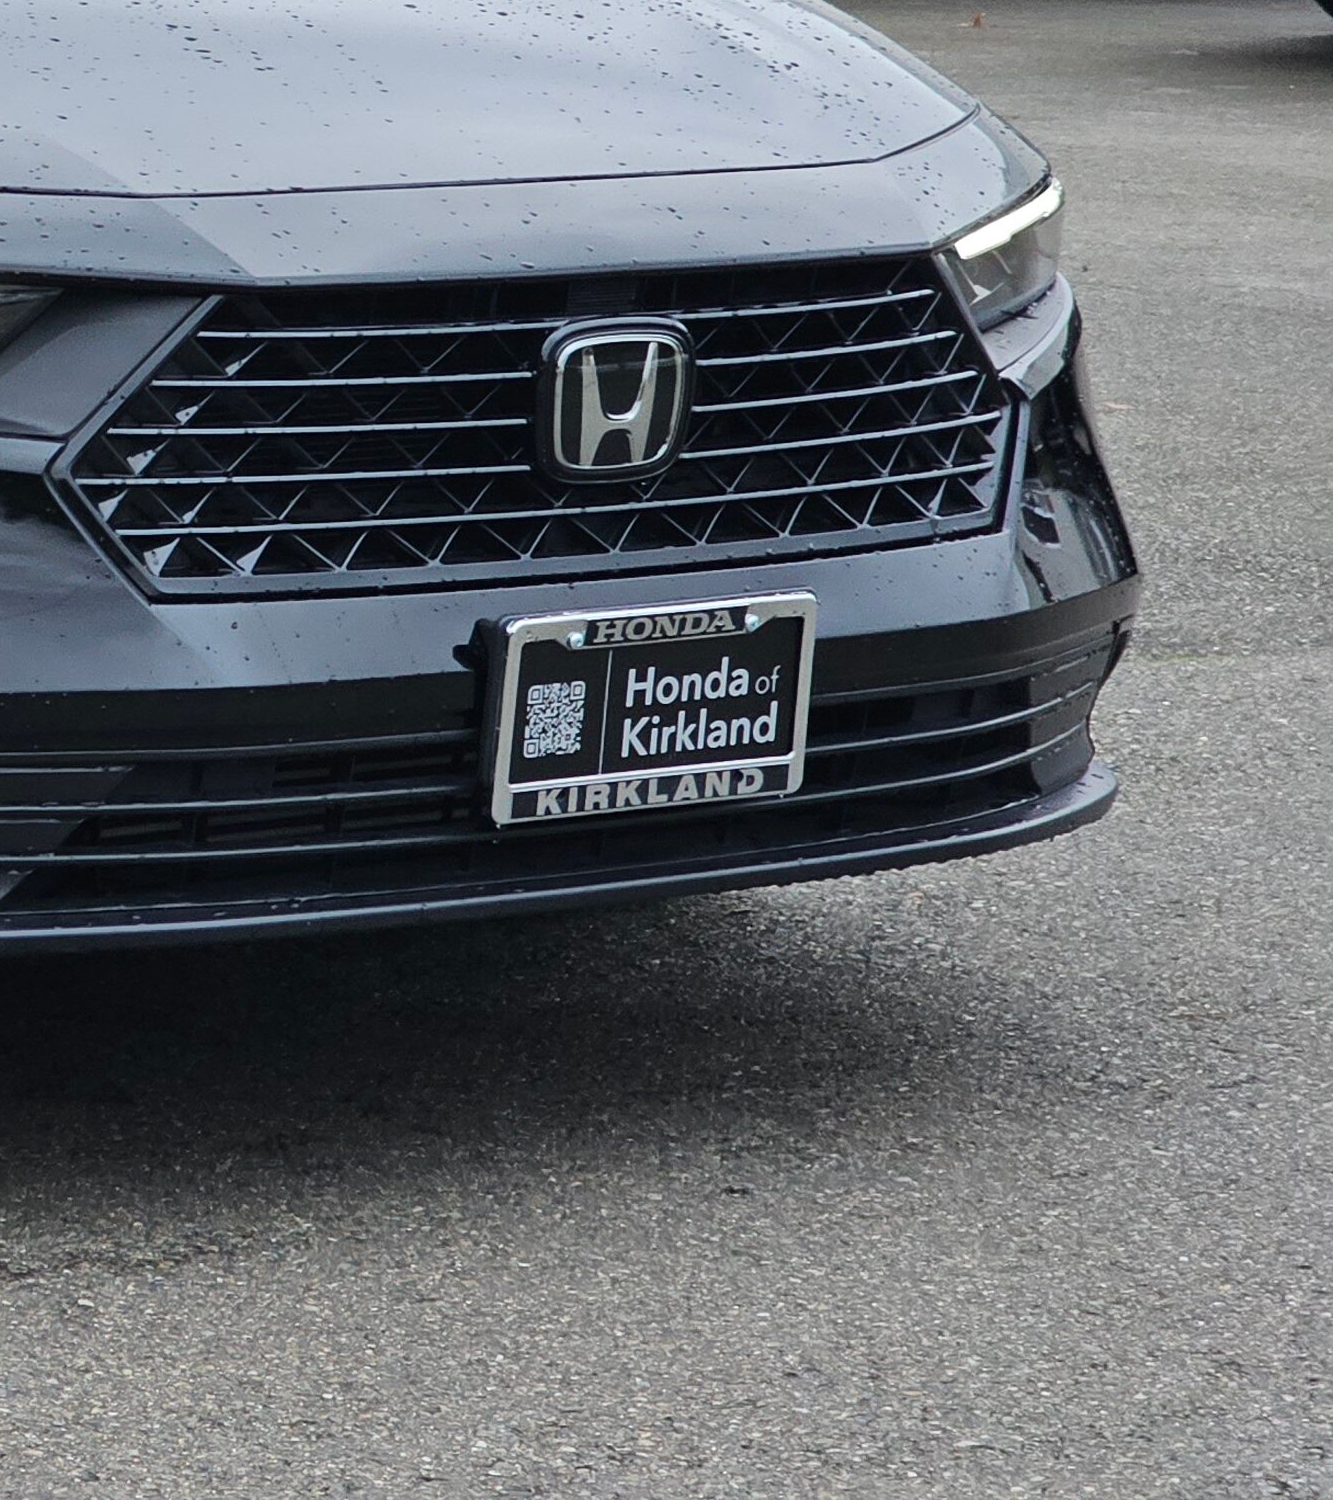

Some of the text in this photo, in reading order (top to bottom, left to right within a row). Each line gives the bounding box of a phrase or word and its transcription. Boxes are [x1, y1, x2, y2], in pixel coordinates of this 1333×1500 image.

[593, 610, 735, 645] HONDA
[625, 656, 782, 708] Honda of
[620, 701, 779, 759] Kirkland
[536, 768, 765, 817] KIRKLAND
